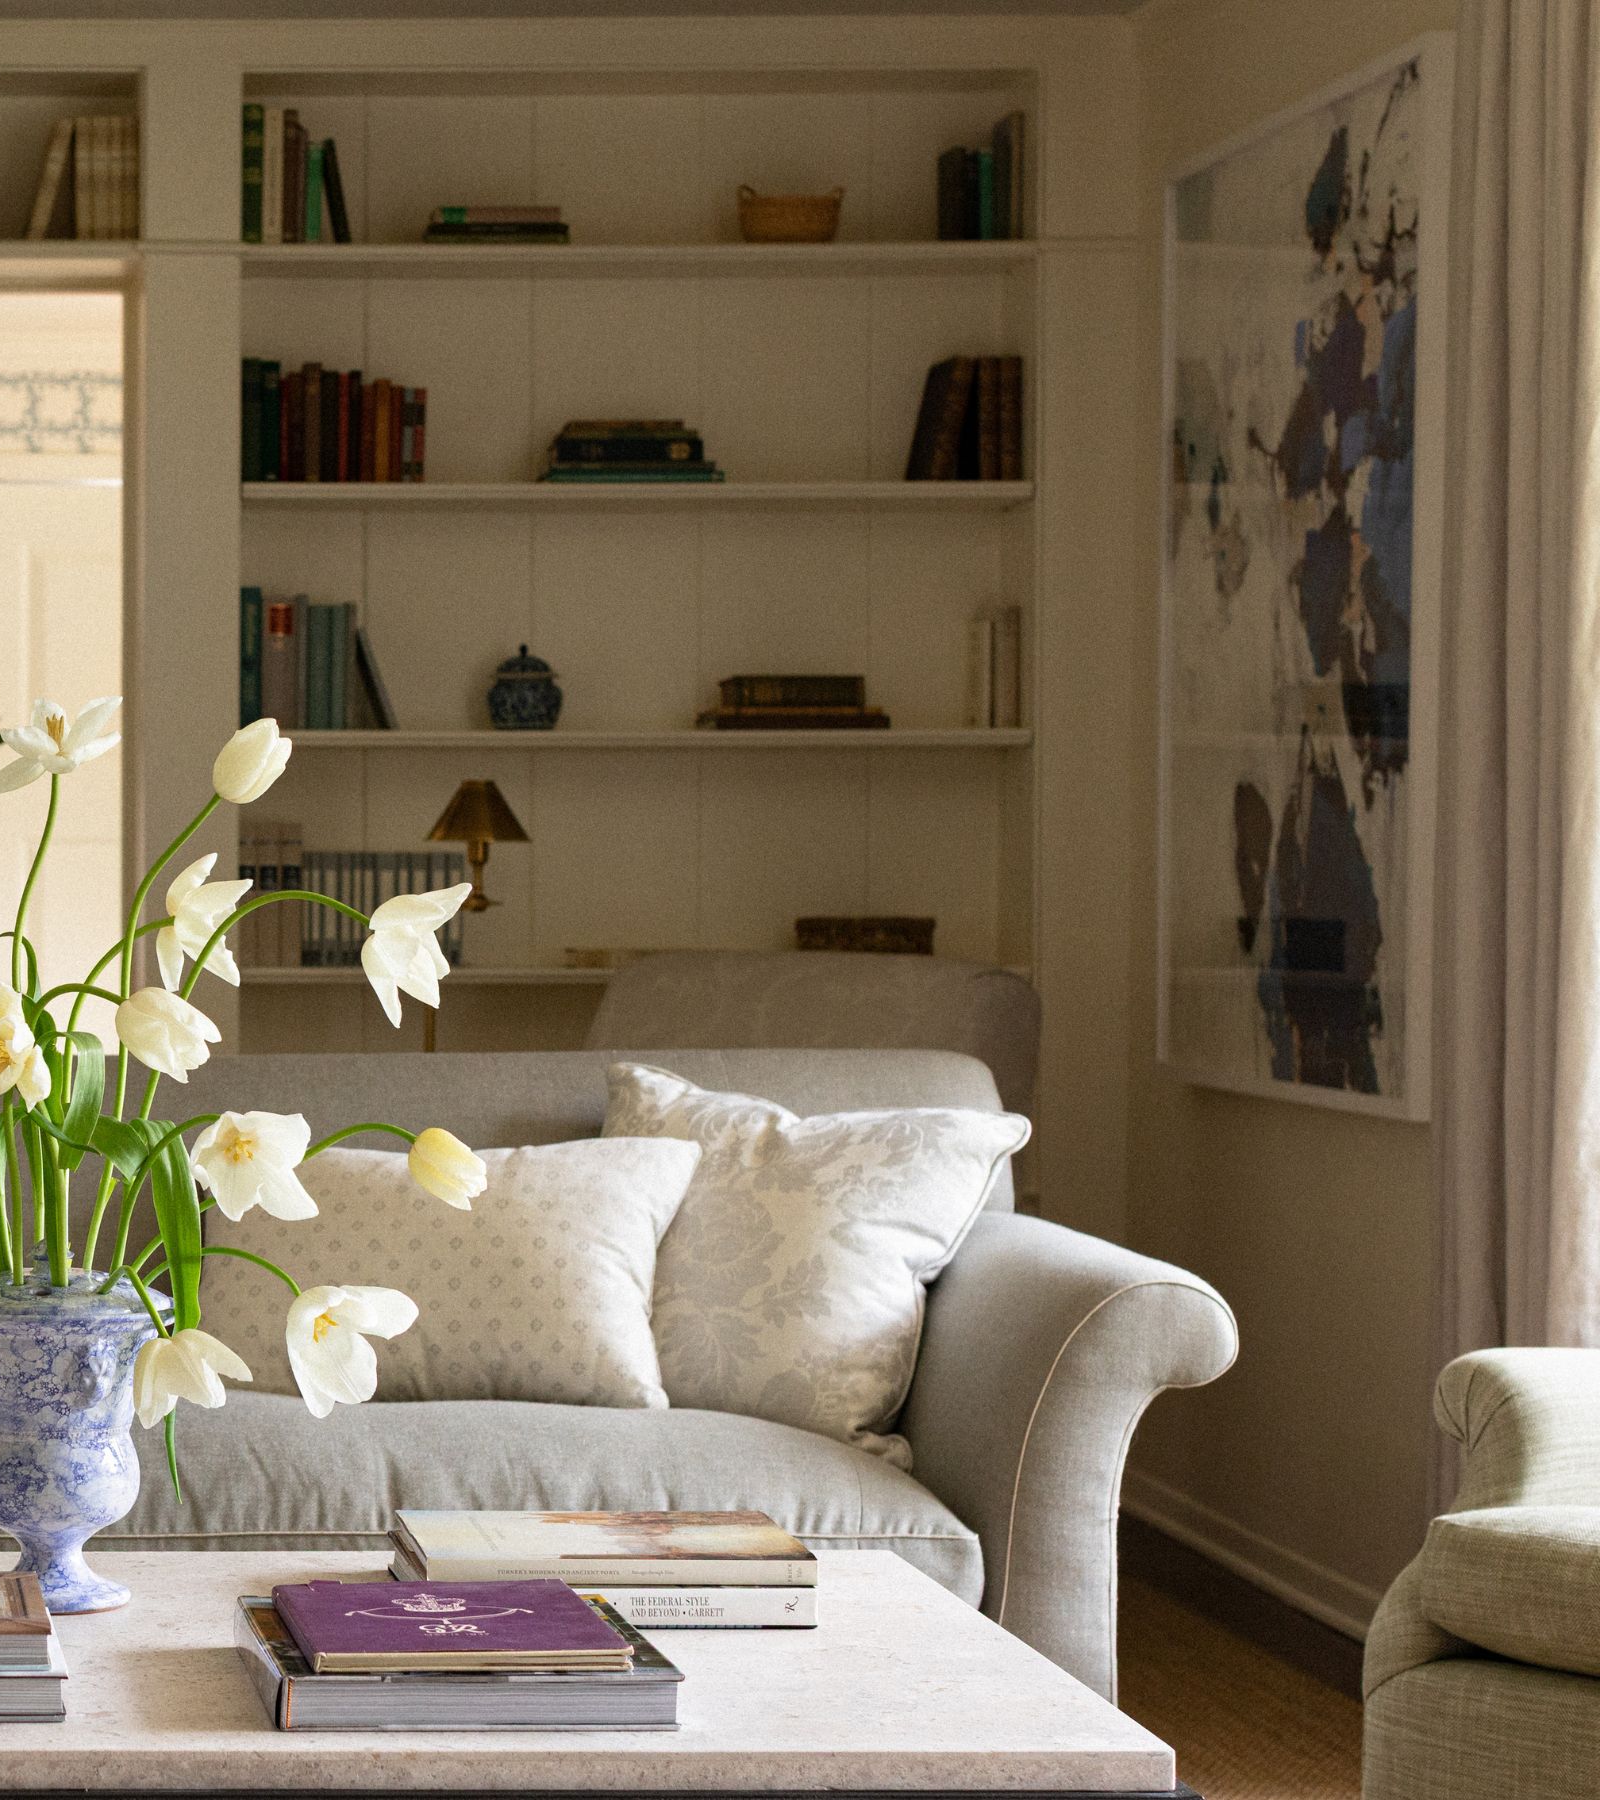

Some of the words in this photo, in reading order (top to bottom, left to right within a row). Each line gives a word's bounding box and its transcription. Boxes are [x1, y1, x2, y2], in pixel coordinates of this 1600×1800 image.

[630, 1597, 647, 1606] THE
[649, 1597, 684, 1606] FEDERAL
[685, 1597, 710, 1606] STYLE
[630, 1608, 647, 1617] AND
[648, 1608, 681, 1617] BEYOND
[688, 1608, 725, 1617] GARRETT
